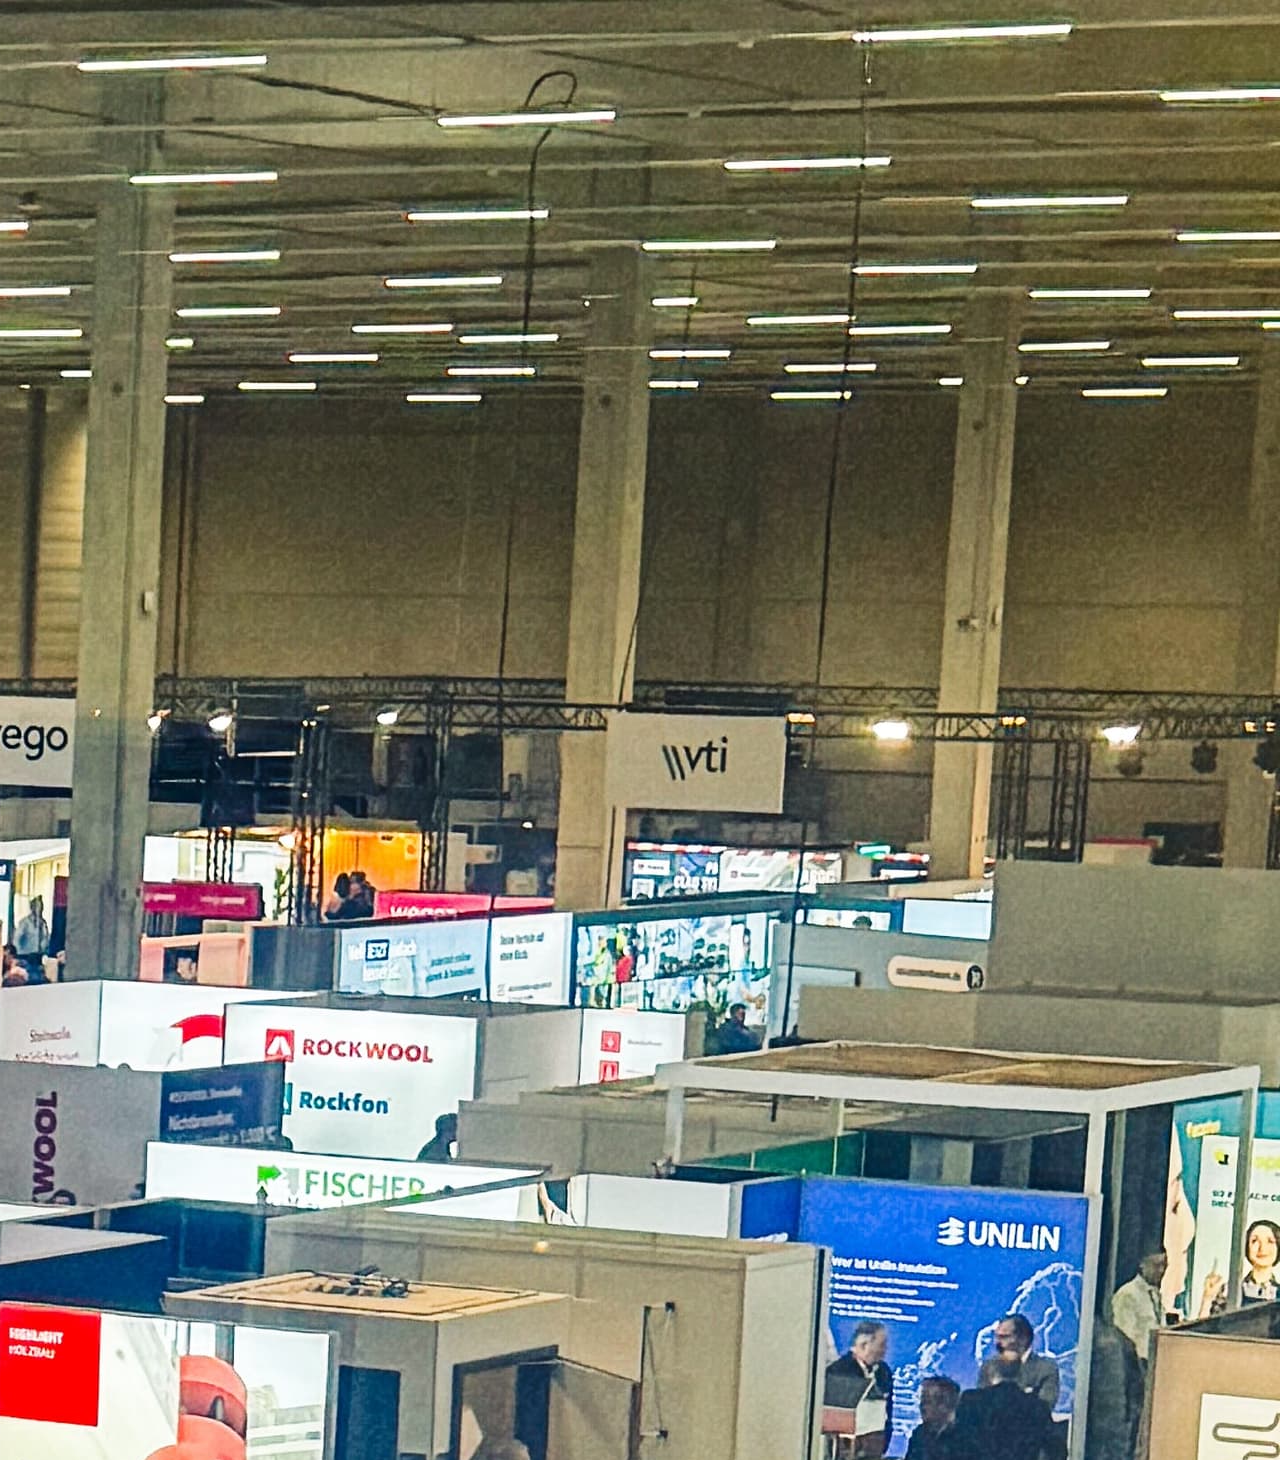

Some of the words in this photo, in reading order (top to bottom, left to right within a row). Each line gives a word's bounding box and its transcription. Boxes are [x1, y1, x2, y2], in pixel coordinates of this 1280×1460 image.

[684, 736, 728, 773] vti
[303, 1039, 433, 1063] ROCKWOOL
[299, 1091, 389, 1114] Rockfon
[968, 1221, 1060, 1251] UNILIN
